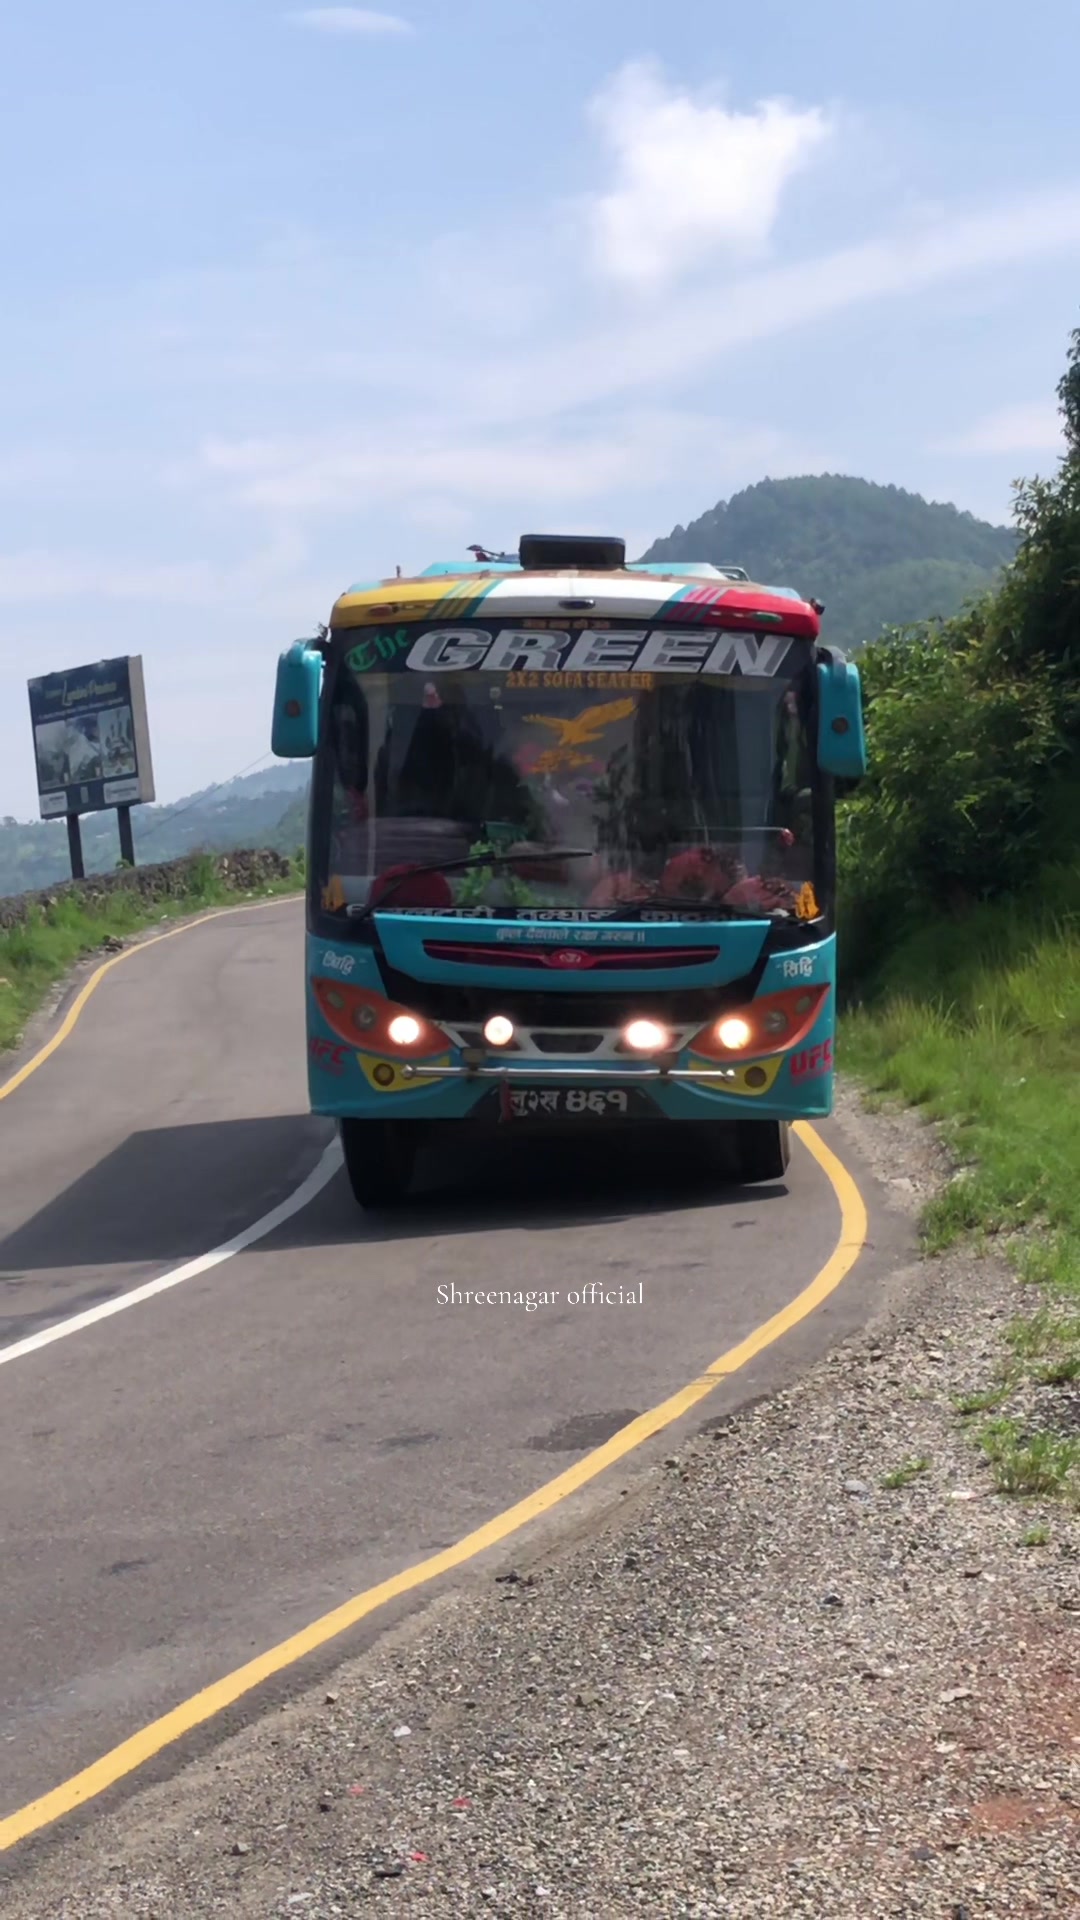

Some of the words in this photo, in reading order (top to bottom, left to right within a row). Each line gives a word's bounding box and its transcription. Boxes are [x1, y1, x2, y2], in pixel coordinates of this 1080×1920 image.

[343, 628, 410, 671] The
[405, 628, 795, 677] GREEN
[505, 672, 539, 688] 2X2
[543, 672, 584, 688] SOFA
[587, 672, 654, 690] SEATER
[789, 1038, 833, 1077] UFC
[565, 1089, 628, 1115] ४६१
